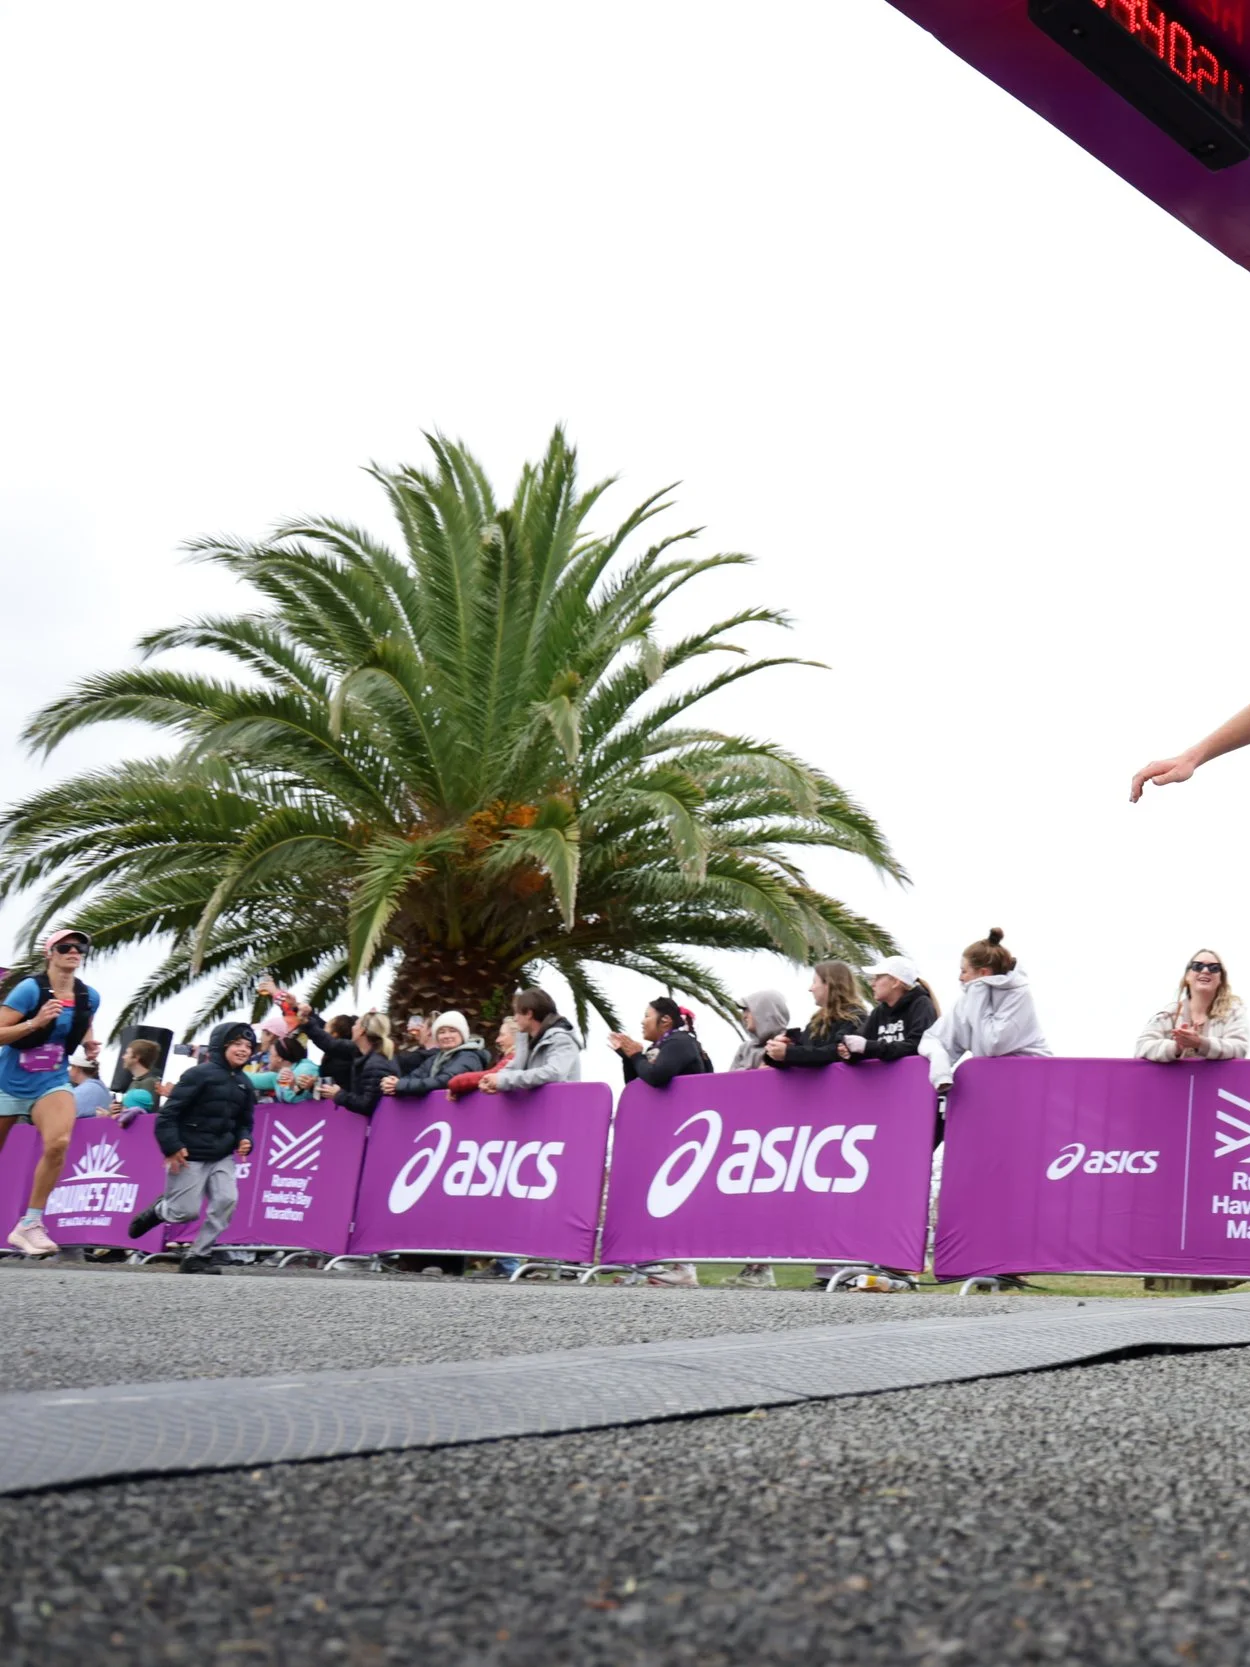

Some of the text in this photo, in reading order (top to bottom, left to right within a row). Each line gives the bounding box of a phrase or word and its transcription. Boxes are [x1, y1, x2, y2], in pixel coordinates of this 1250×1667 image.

[442, 1140, 566, 1200] asics
[716, 1124, 878, 1195] asics
[1082, 1149, 1160, 1175] asics
